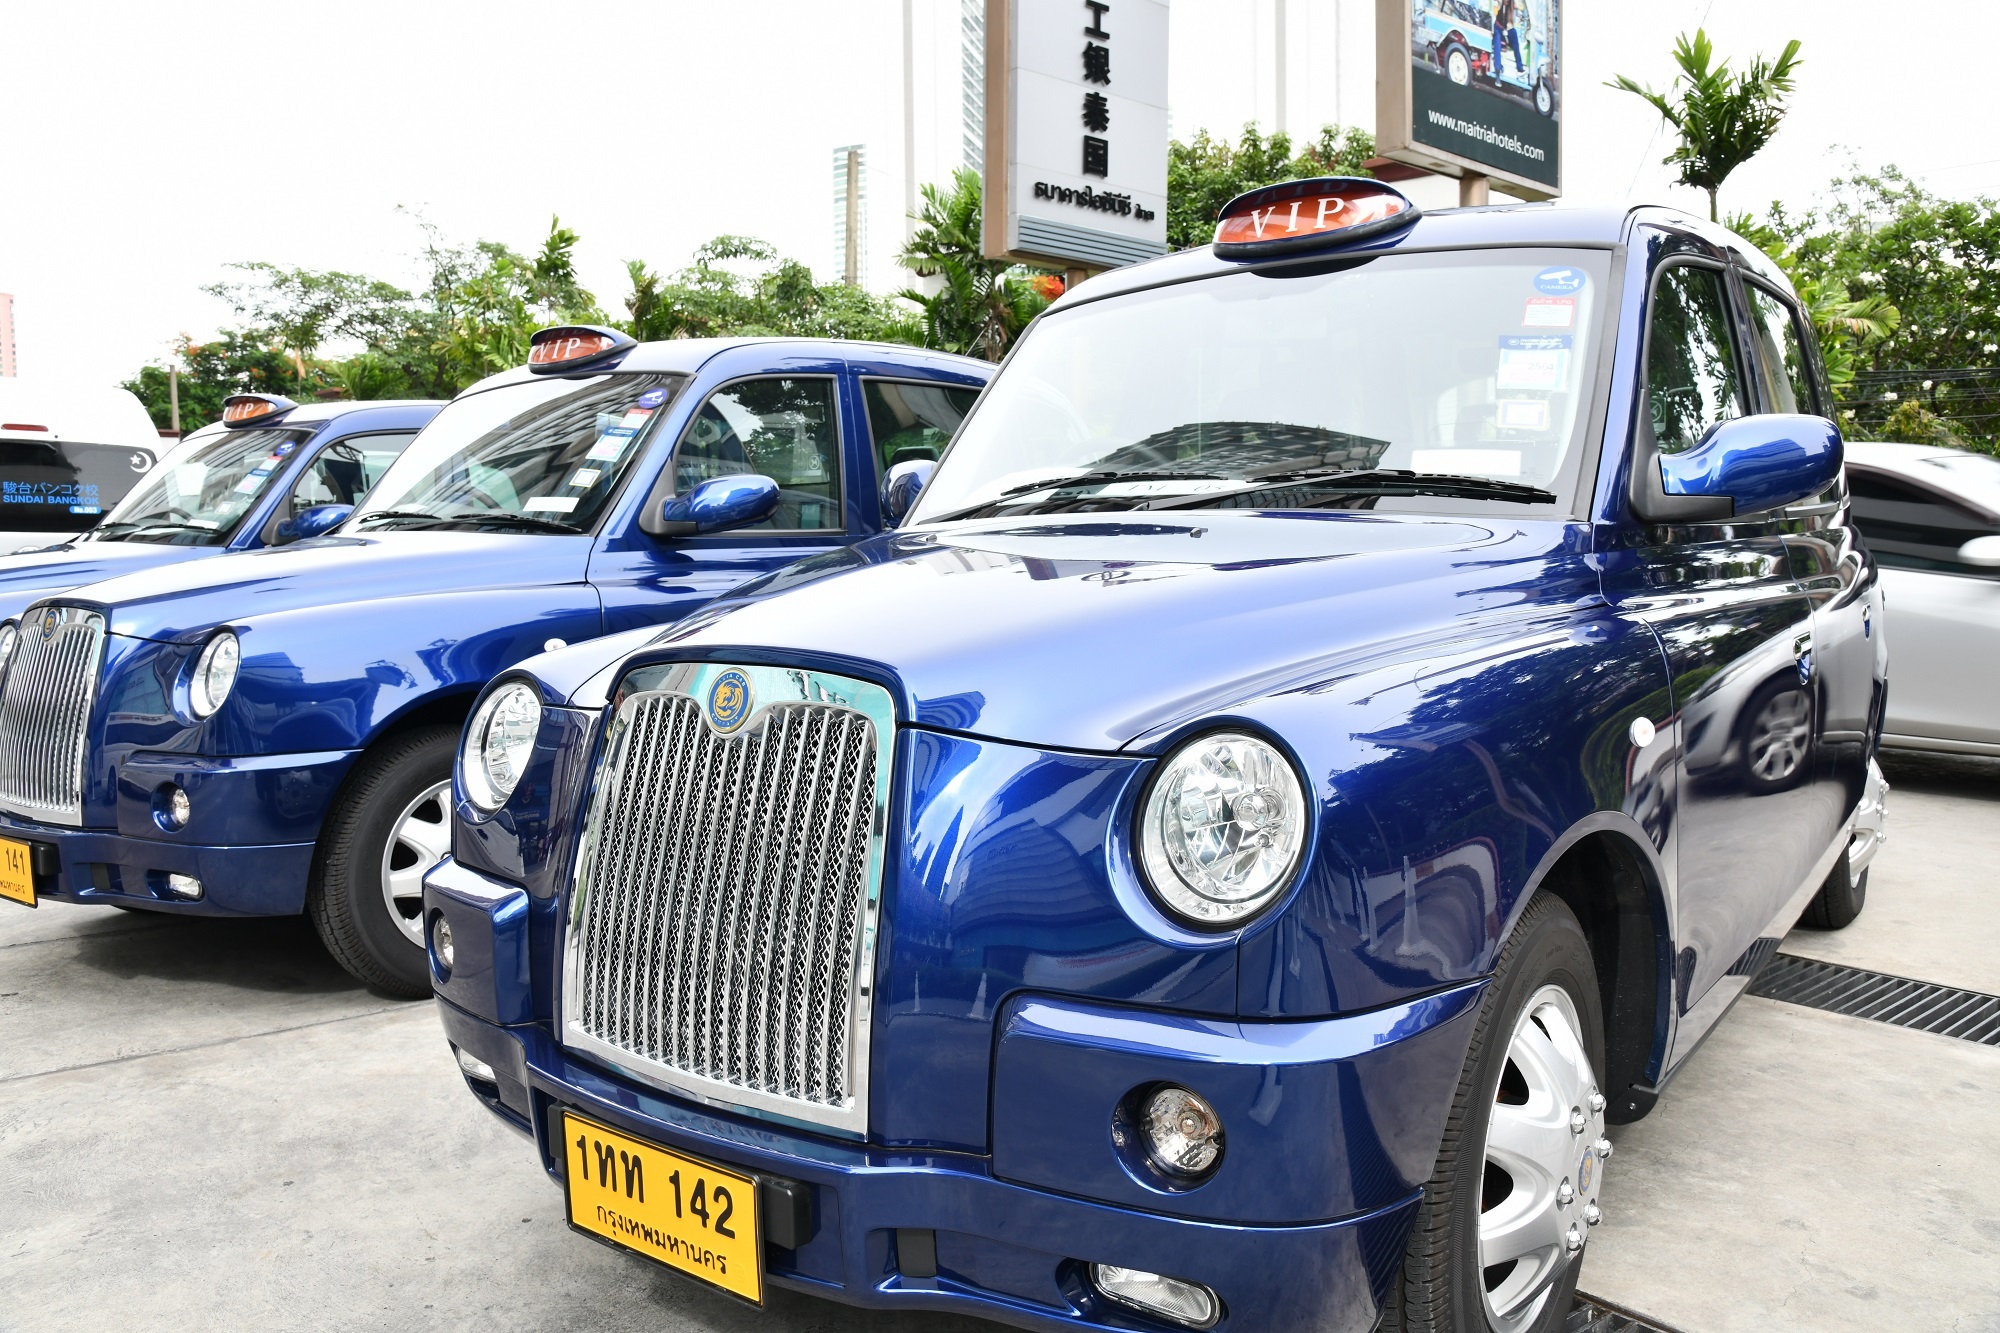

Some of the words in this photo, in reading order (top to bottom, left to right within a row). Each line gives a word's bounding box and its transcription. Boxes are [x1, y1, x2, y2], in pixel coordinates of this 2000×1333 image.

[1428, 109, 1545, 162] www.maitriahotels.com
[1250, 197, 1345, 238] VIP
[539, 337, 581, 360] VIP
[3, 481, 98, 496] 駿台バンコク校
[3, 495, 43, 503] SUNDAI
[48, 496, 99, 505] BANGKOK
[6, 847, 25, 875] 141
[576, 1135, 644, 1204] 1ทท
[669, 1170, 736, 1240] 142
[597, 1205, 727, 1275] กรุงเทพมหานคร
